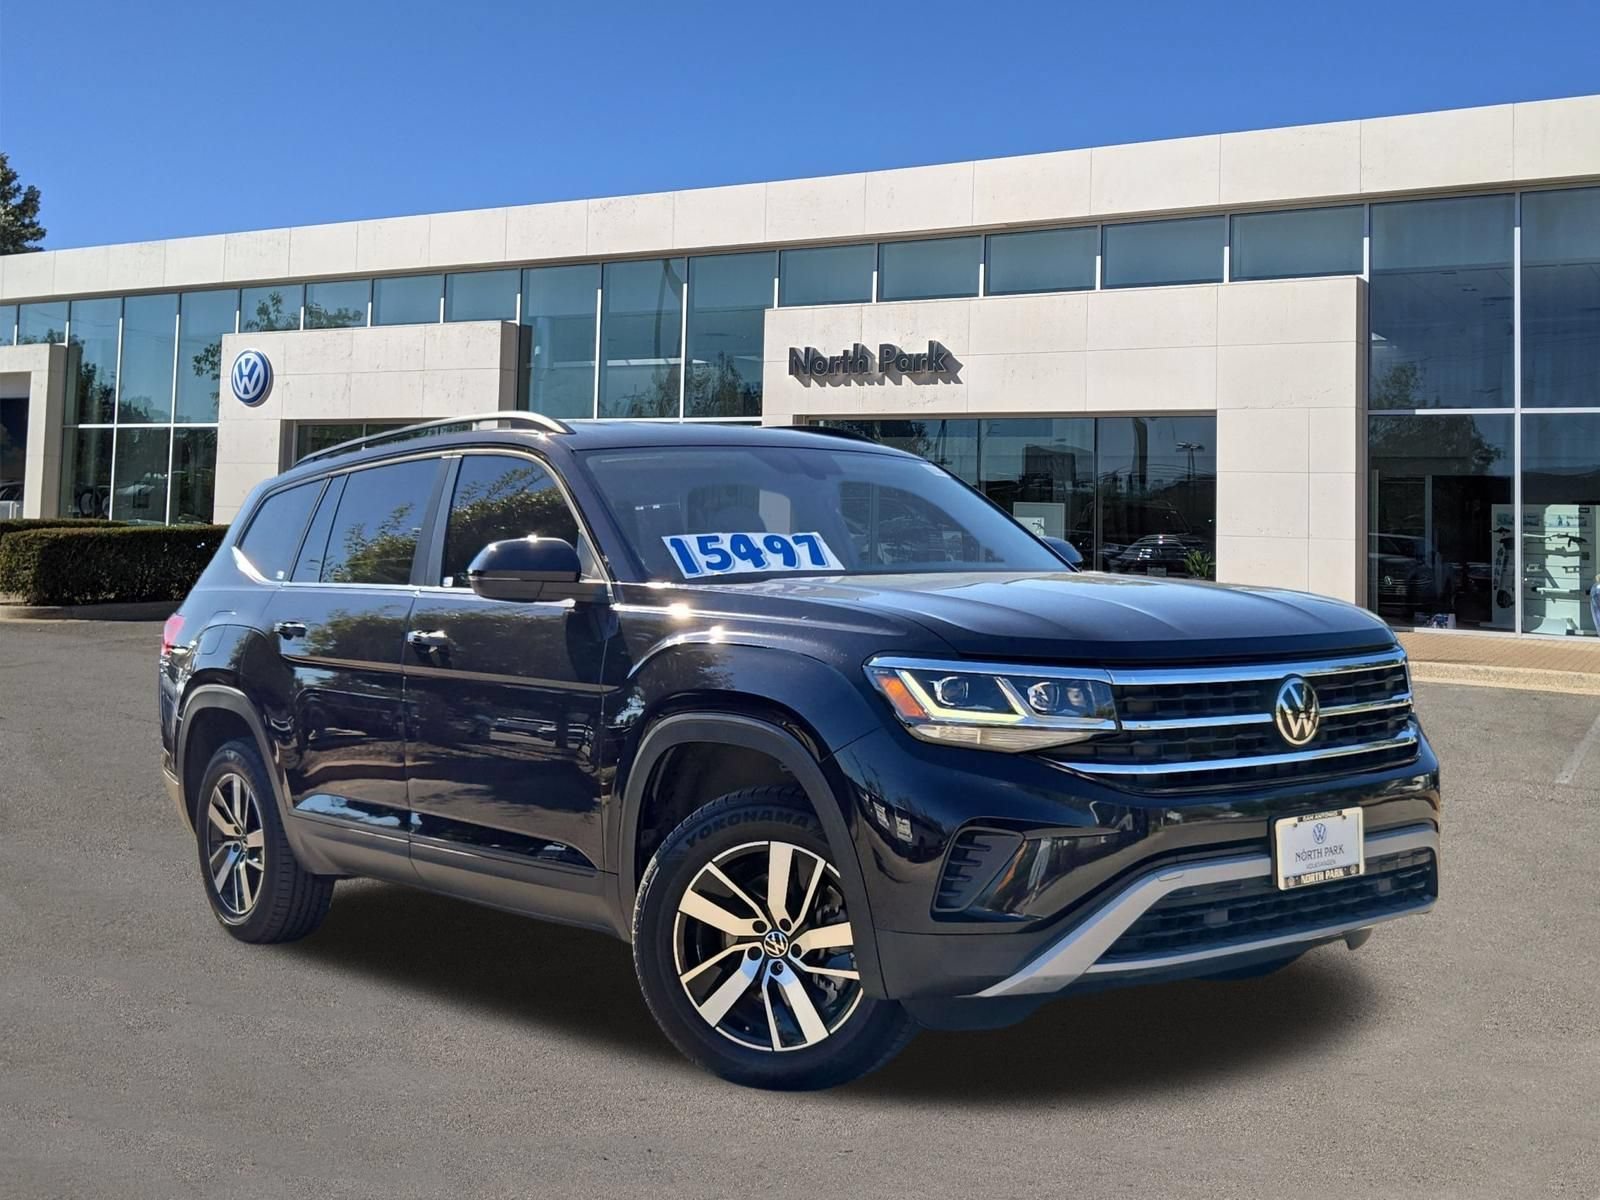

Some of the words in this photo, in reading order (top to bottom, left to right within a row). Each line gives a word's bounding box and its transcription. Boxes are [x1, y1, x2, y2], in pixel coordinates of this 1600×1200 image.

[232, 350, 266, 402] VW
[788, 343, 870, 376] North
[878, 340, 948, 373] Park
[670, 533, 826, 575] 15497
[685, 809, 809, 848] YOKOHAMA
[1295, 849, 1323, 863] NORTH
[1324, 844, 1345, 858] PARK
[1301, 871, 1324, 884] NORTH
[1325, 868, 1344, 880] PARK
